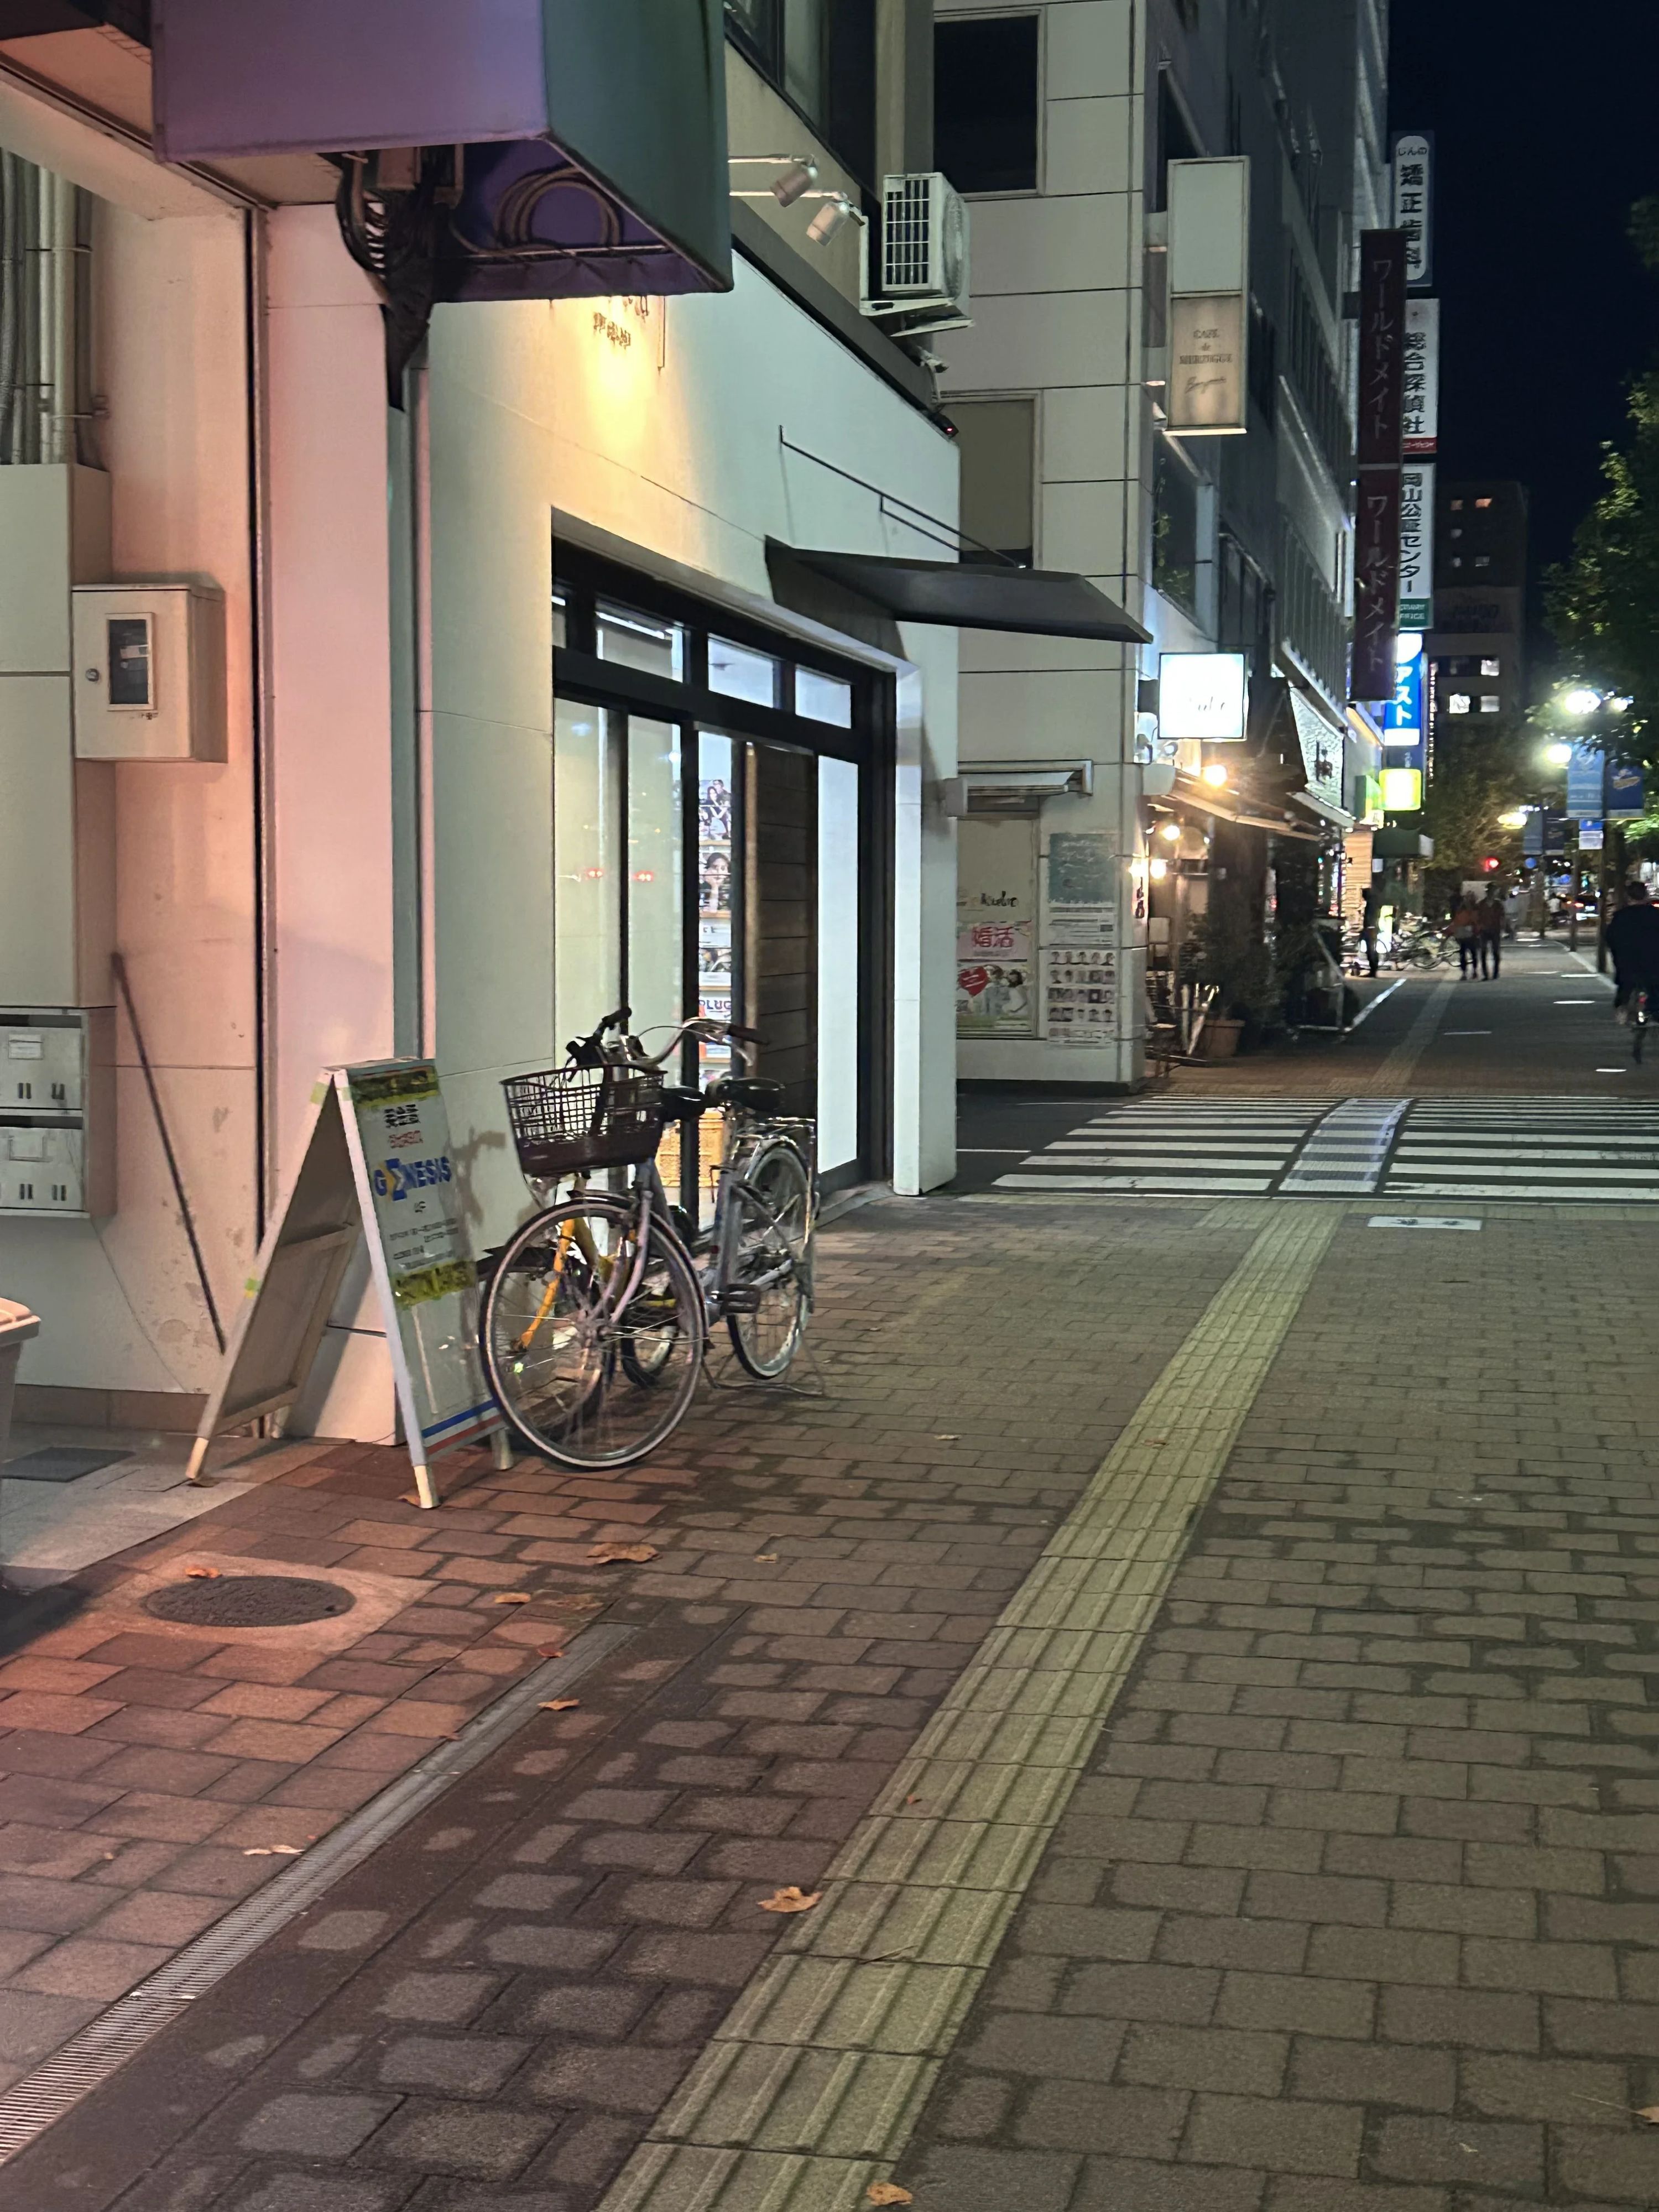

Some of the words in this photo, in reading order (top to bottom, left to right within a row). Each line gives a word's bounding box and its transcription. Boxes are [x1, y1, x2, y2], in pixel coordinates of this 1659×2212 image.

[1368, 259, 1394, 440] ワールドメイト
[1364, 496, 1390, 672] ワールドメイト
